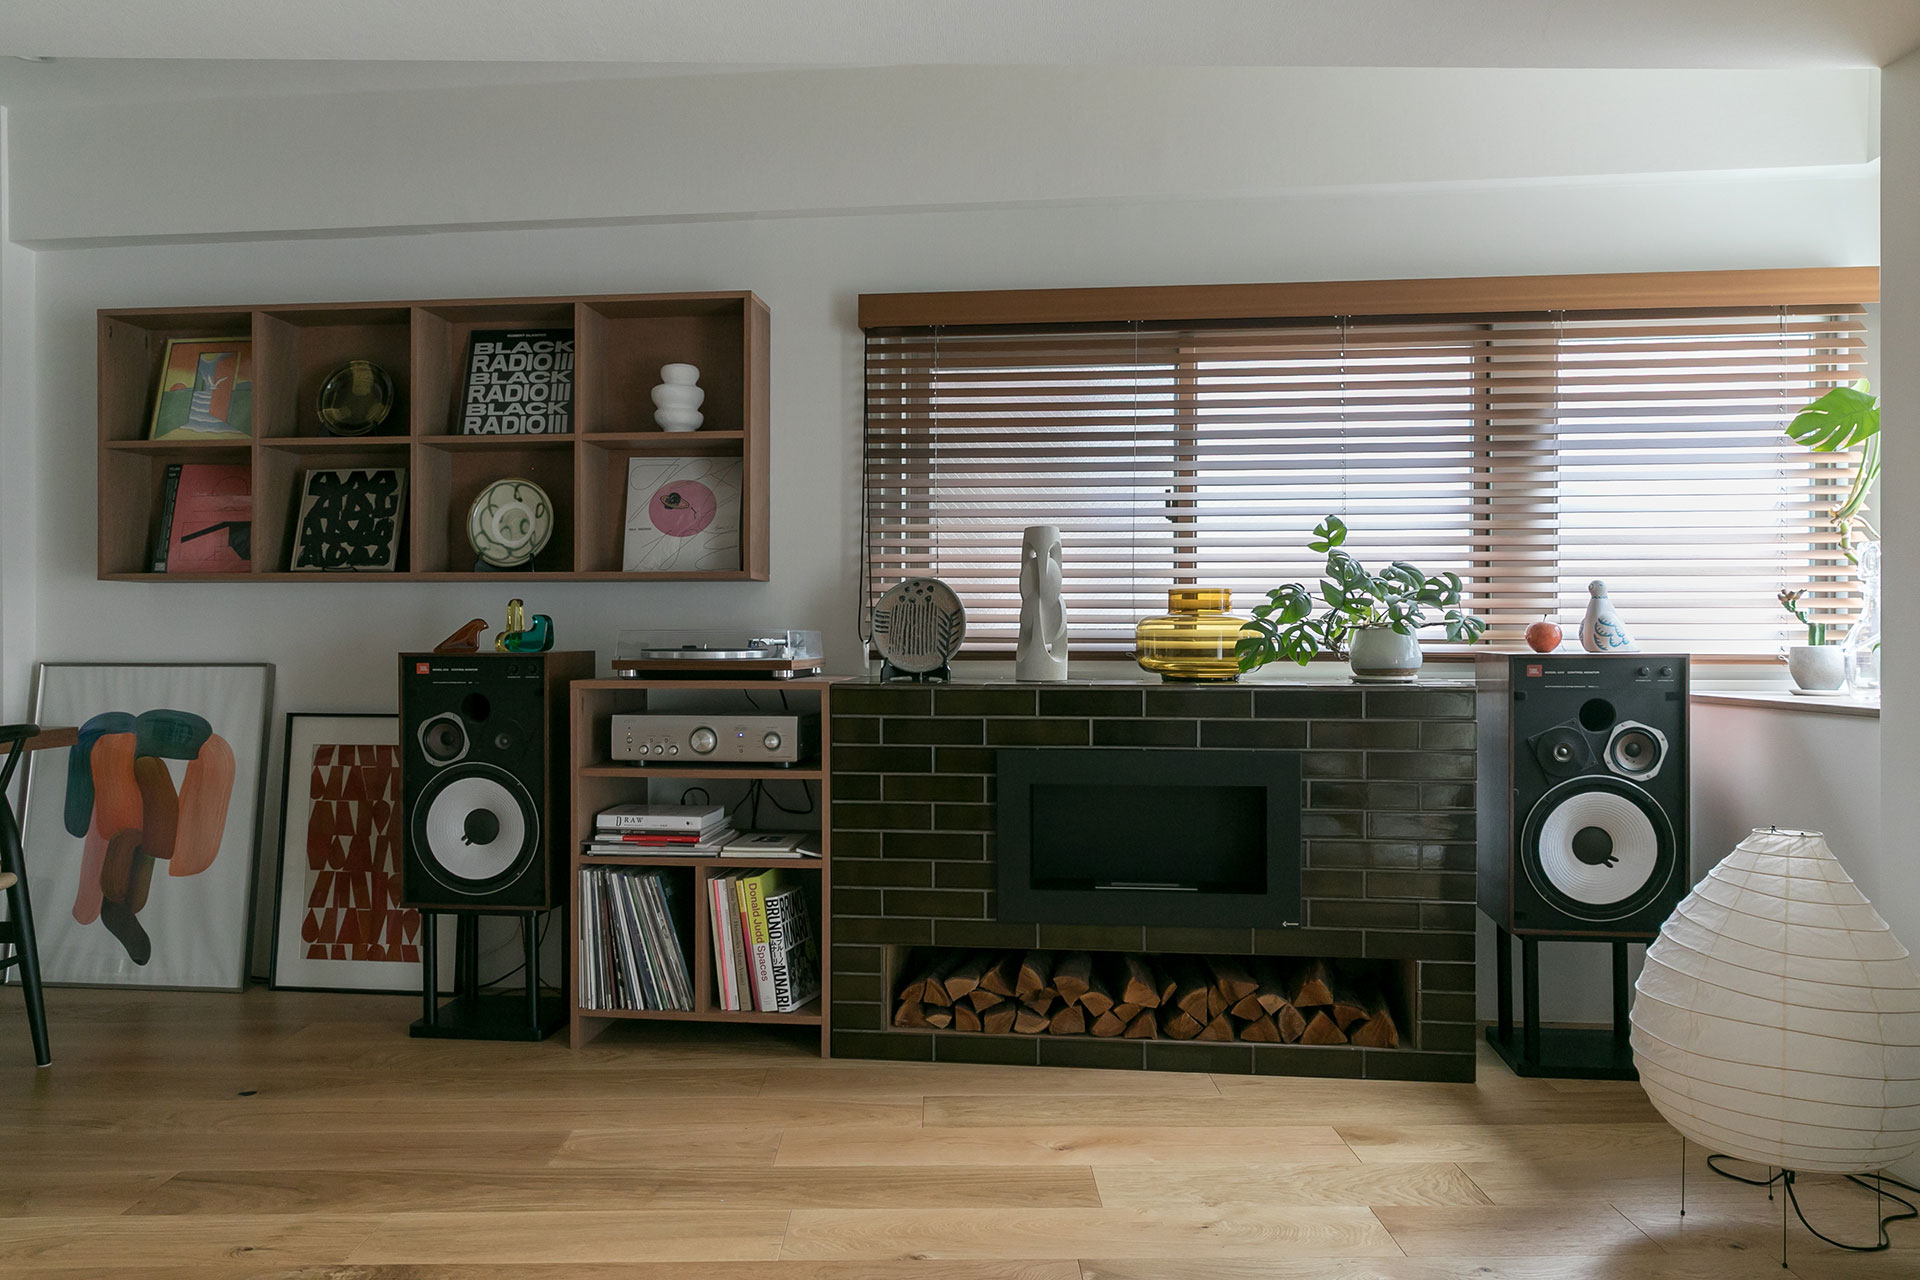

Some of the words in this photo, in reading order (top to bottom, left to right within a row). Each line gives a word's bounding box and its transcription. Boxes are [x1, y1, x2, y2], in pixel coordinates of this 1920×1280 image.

[473, 341, 575, 355] BLACK
[471, 353, 553, 373] RADIO
[553, 352, 575, 371] III
[469, 371, 572, 385] BLACK
[467, 384, 549, 403] RADIO
[550, 383, 571, 402] III
[465, 402, 569, 416] BLACK
[463, 415, 546, 435] RADIO
[547, 414, 568, 433] III
[748, 882, 761, 918] Donald
[766, 899, 783, 940] BRUNO
[753, 918, 765, 944] Judd
[757, 945, 769, 982] Spaces
[773, 965, 791, 1007] MUNARI
